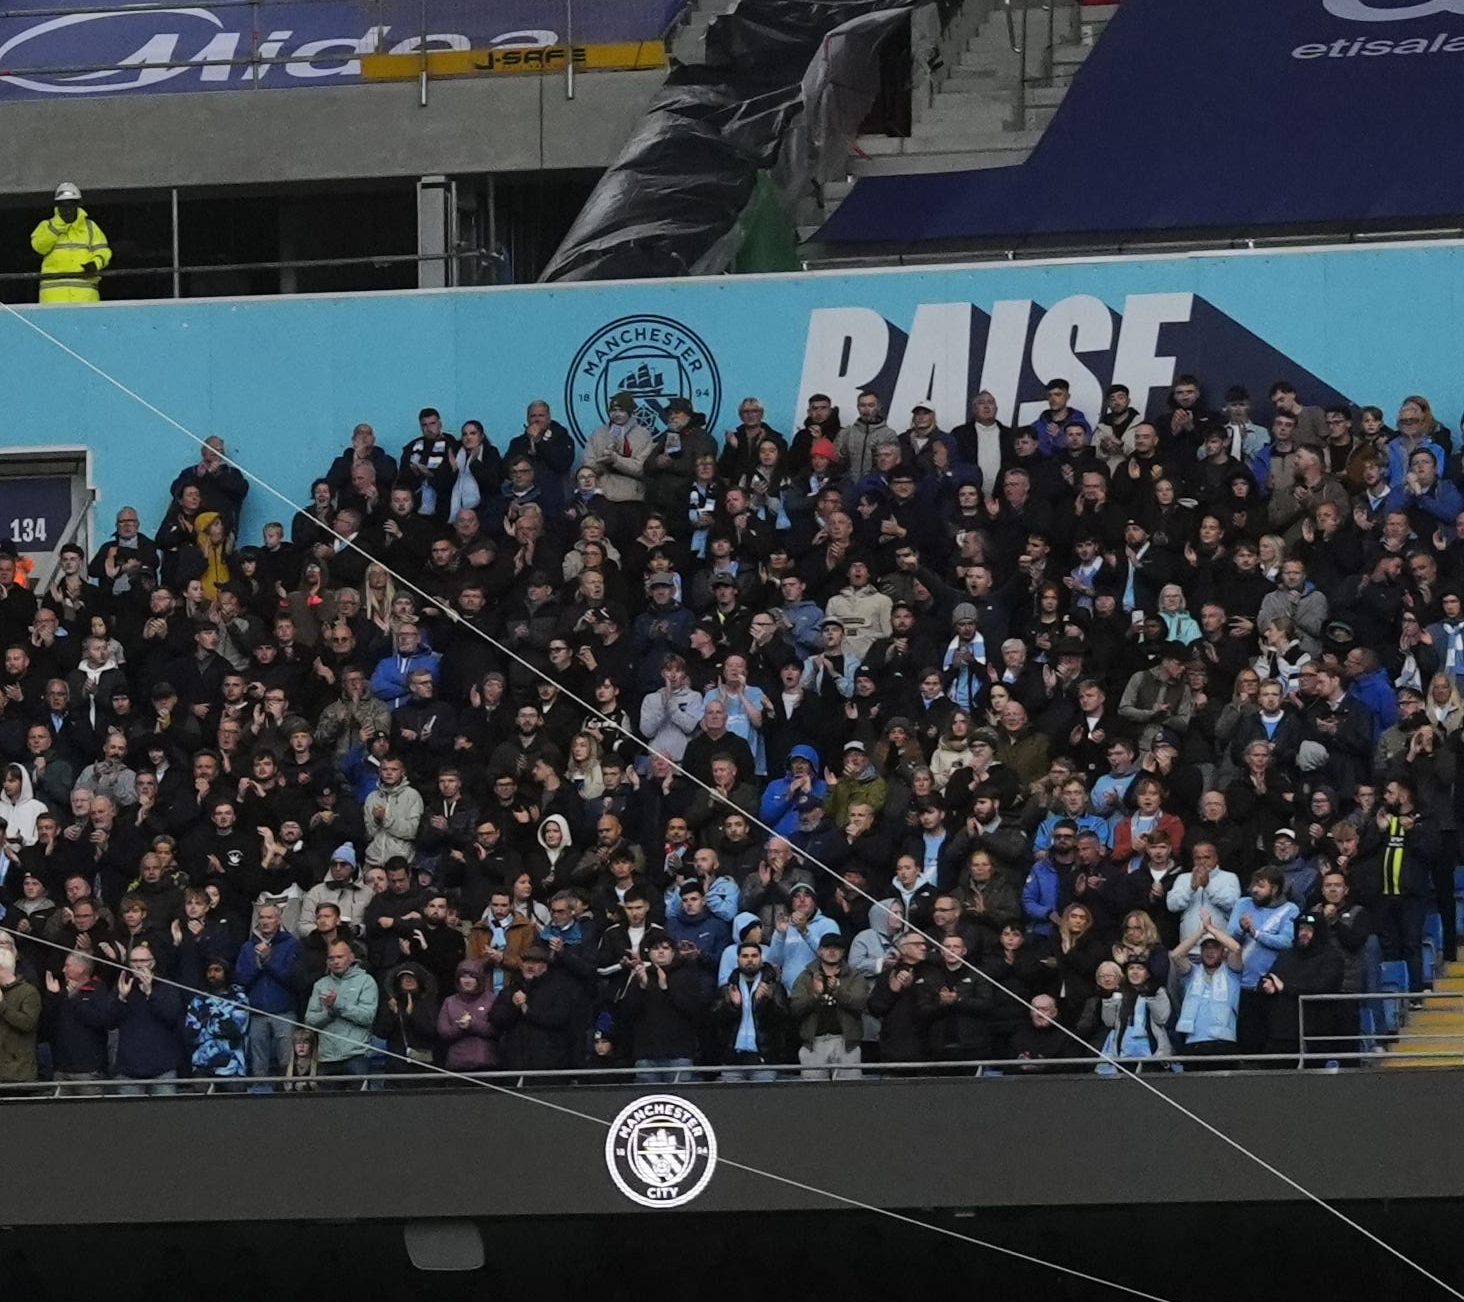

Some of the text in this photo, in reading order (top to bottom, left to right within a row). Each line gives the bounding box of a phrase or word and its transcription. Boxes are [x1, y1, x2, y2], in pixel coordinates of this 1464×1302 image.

[582, 327, 704, 377] MANCHESTER
[10, 517, 48, 543] 134
[618, 1103, 704, 1139] MANCHESTER
[646, 1186, 680, 1199] CITY
